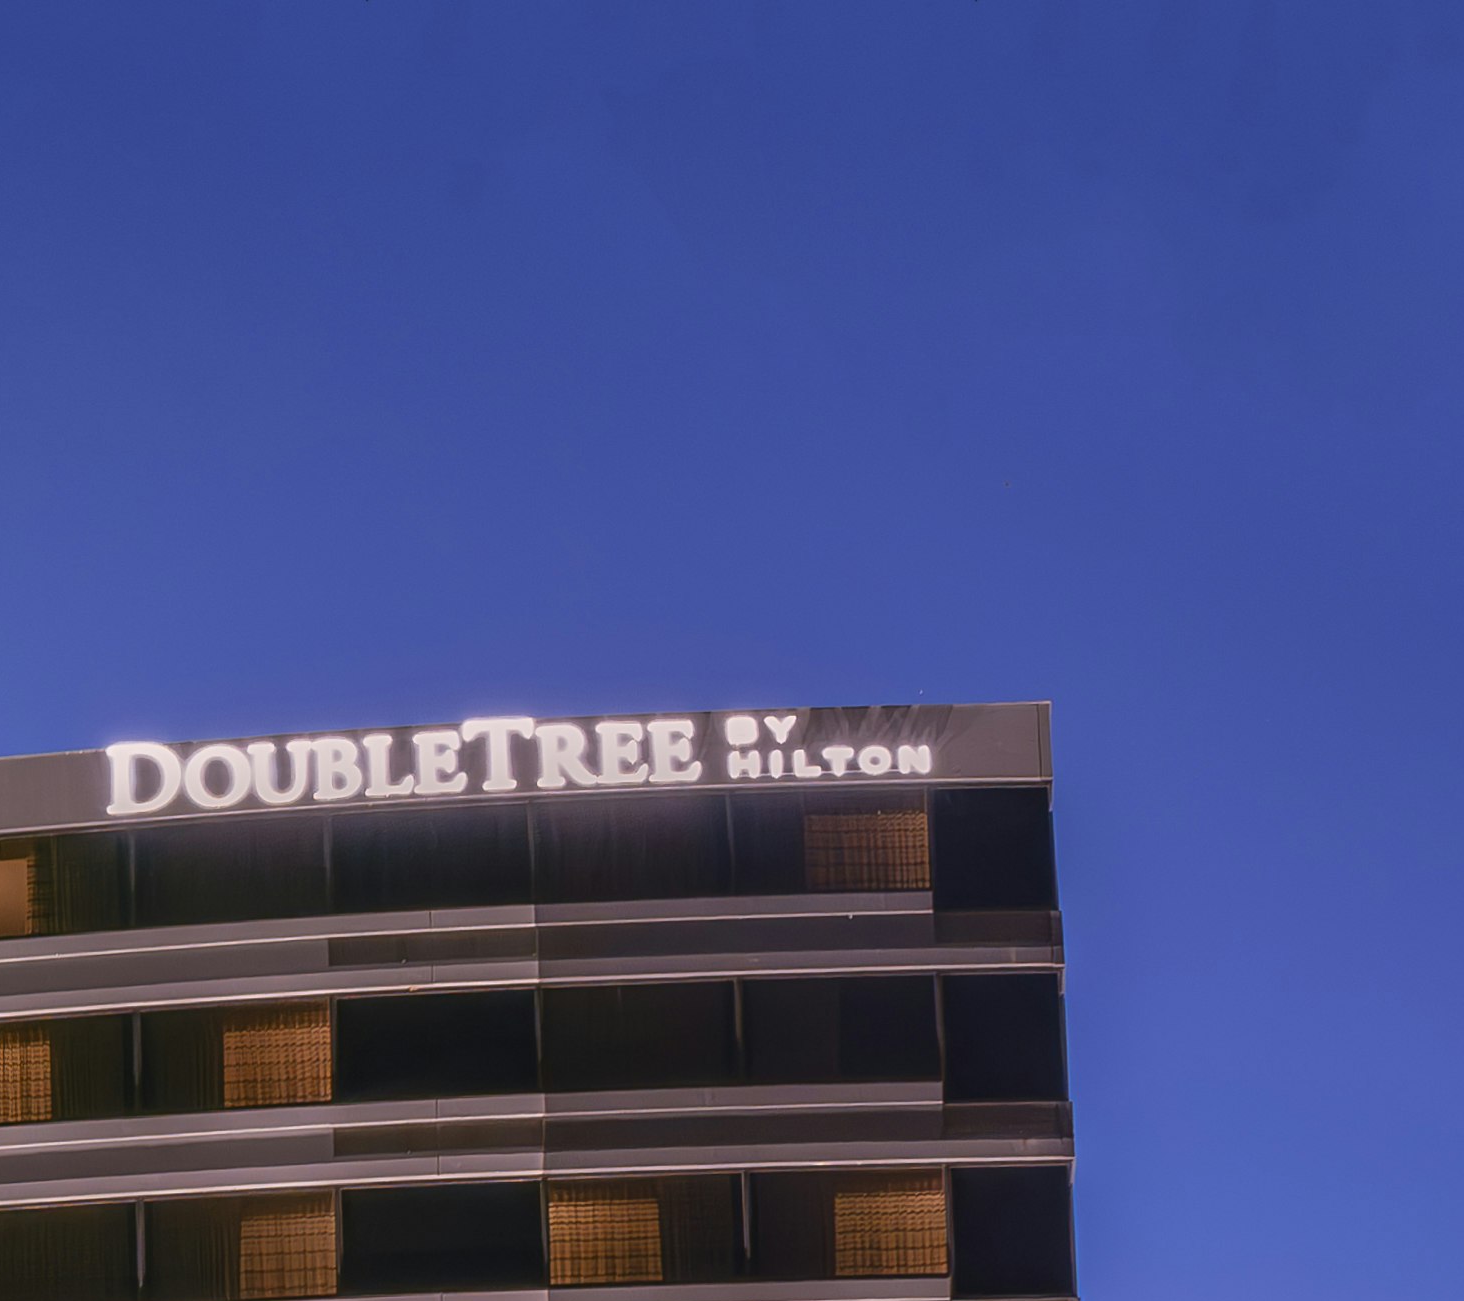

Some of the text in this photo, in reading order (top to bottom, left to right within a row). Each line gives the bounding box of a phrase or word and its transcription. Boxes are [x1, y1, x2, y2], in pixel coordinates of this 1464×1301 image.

[726, 715, 797, 745] BY
[105, 716, 703, 816] DOUBLETREE
[728, 745, 932, 779] HILTON
